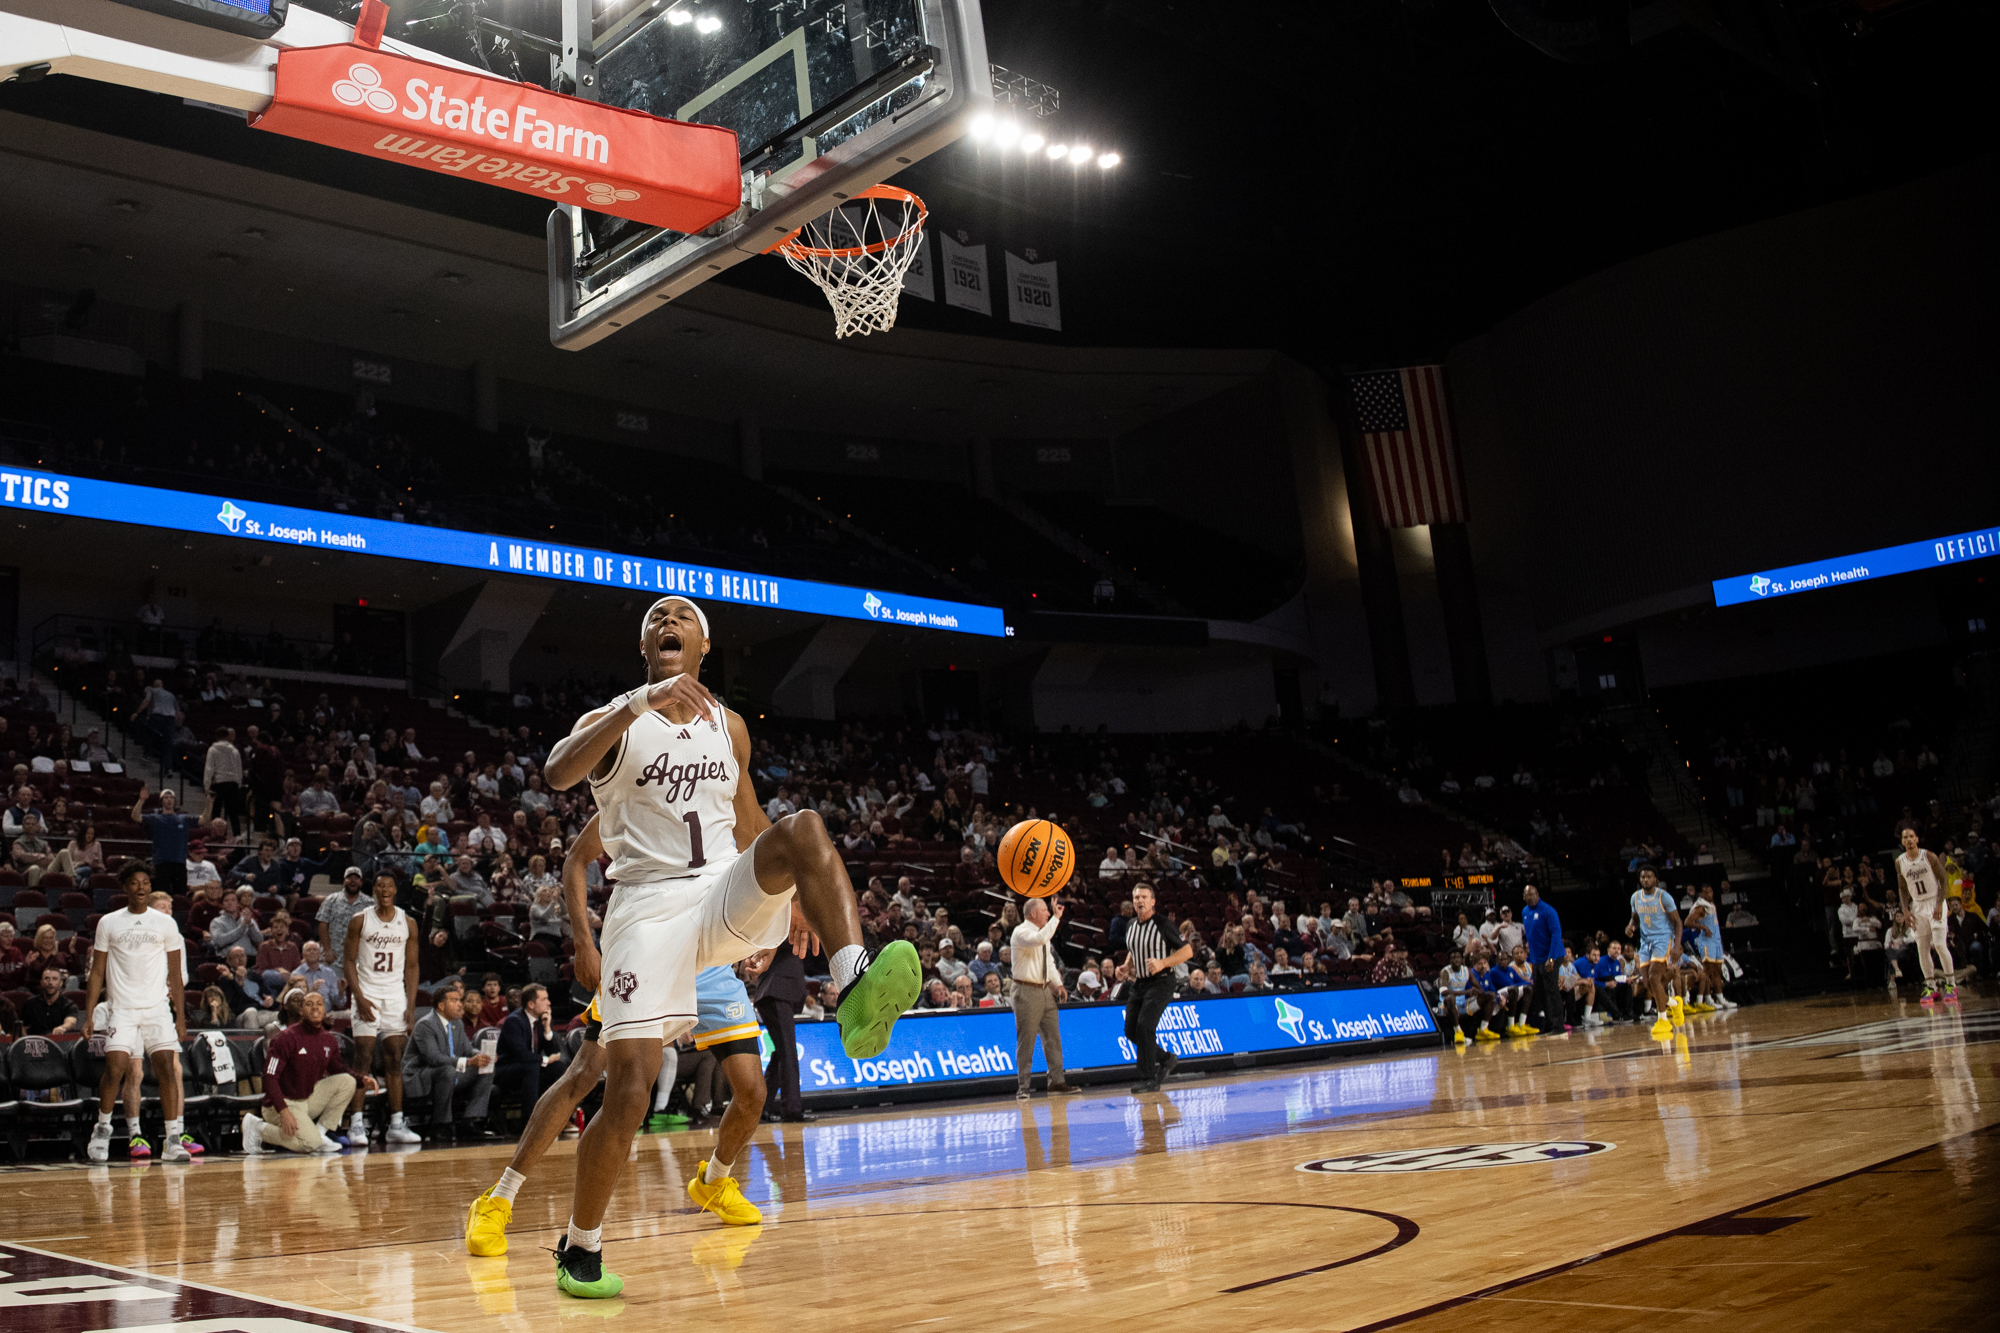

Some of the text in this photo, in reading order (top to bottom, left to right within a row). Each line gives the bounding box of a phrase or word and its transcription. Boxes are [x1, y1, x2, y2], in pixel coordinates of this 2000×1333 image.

[953, 268, 981, 291] 1921
[1017, 286, 1052, 308] 1920
[354, 360, 391, 382] 222
[617, 412, 648, 431] 223
[846, 443, 878, 461] 224
[1037, 448, 1071, 463] 225
[1, 473, 69, 509] TICS
[245, 520, 366, 549] St. Joseph Health
[1935, 531, 2000, 562] OFFICI
[489, 542, 778, 604] A MEMBER OF ST. LUKE'S HEALTH
[1771, 566, 1869, 594] St. Joseph Health
[881, 606, 958, 628] St. Joseph Health
[636, 752, 731, 803] Aggies
[683, 811, 707, 868] 1
[1020, 837, 1042, 875] NCAA
[1039, 839, 1065, 887] Wilson
[1906, 867, 1928, 880] Aggies
[1915, 880, 1927, 895] 11
[1644, 915, 1651, 927] 4
[118, 929, 159, 949] Aggies
[366, 931, 402, 949] Aggies
[373, 952, 394, 972] 21
[1183, 1005, 1200, 1028] OF
[1308, 1009, 1428, 1041] St. Joseph Health
[1178, 1028, 1223, 1055] HEALTH
[810, 1045, 1013, 1086] St. Joseph Health
